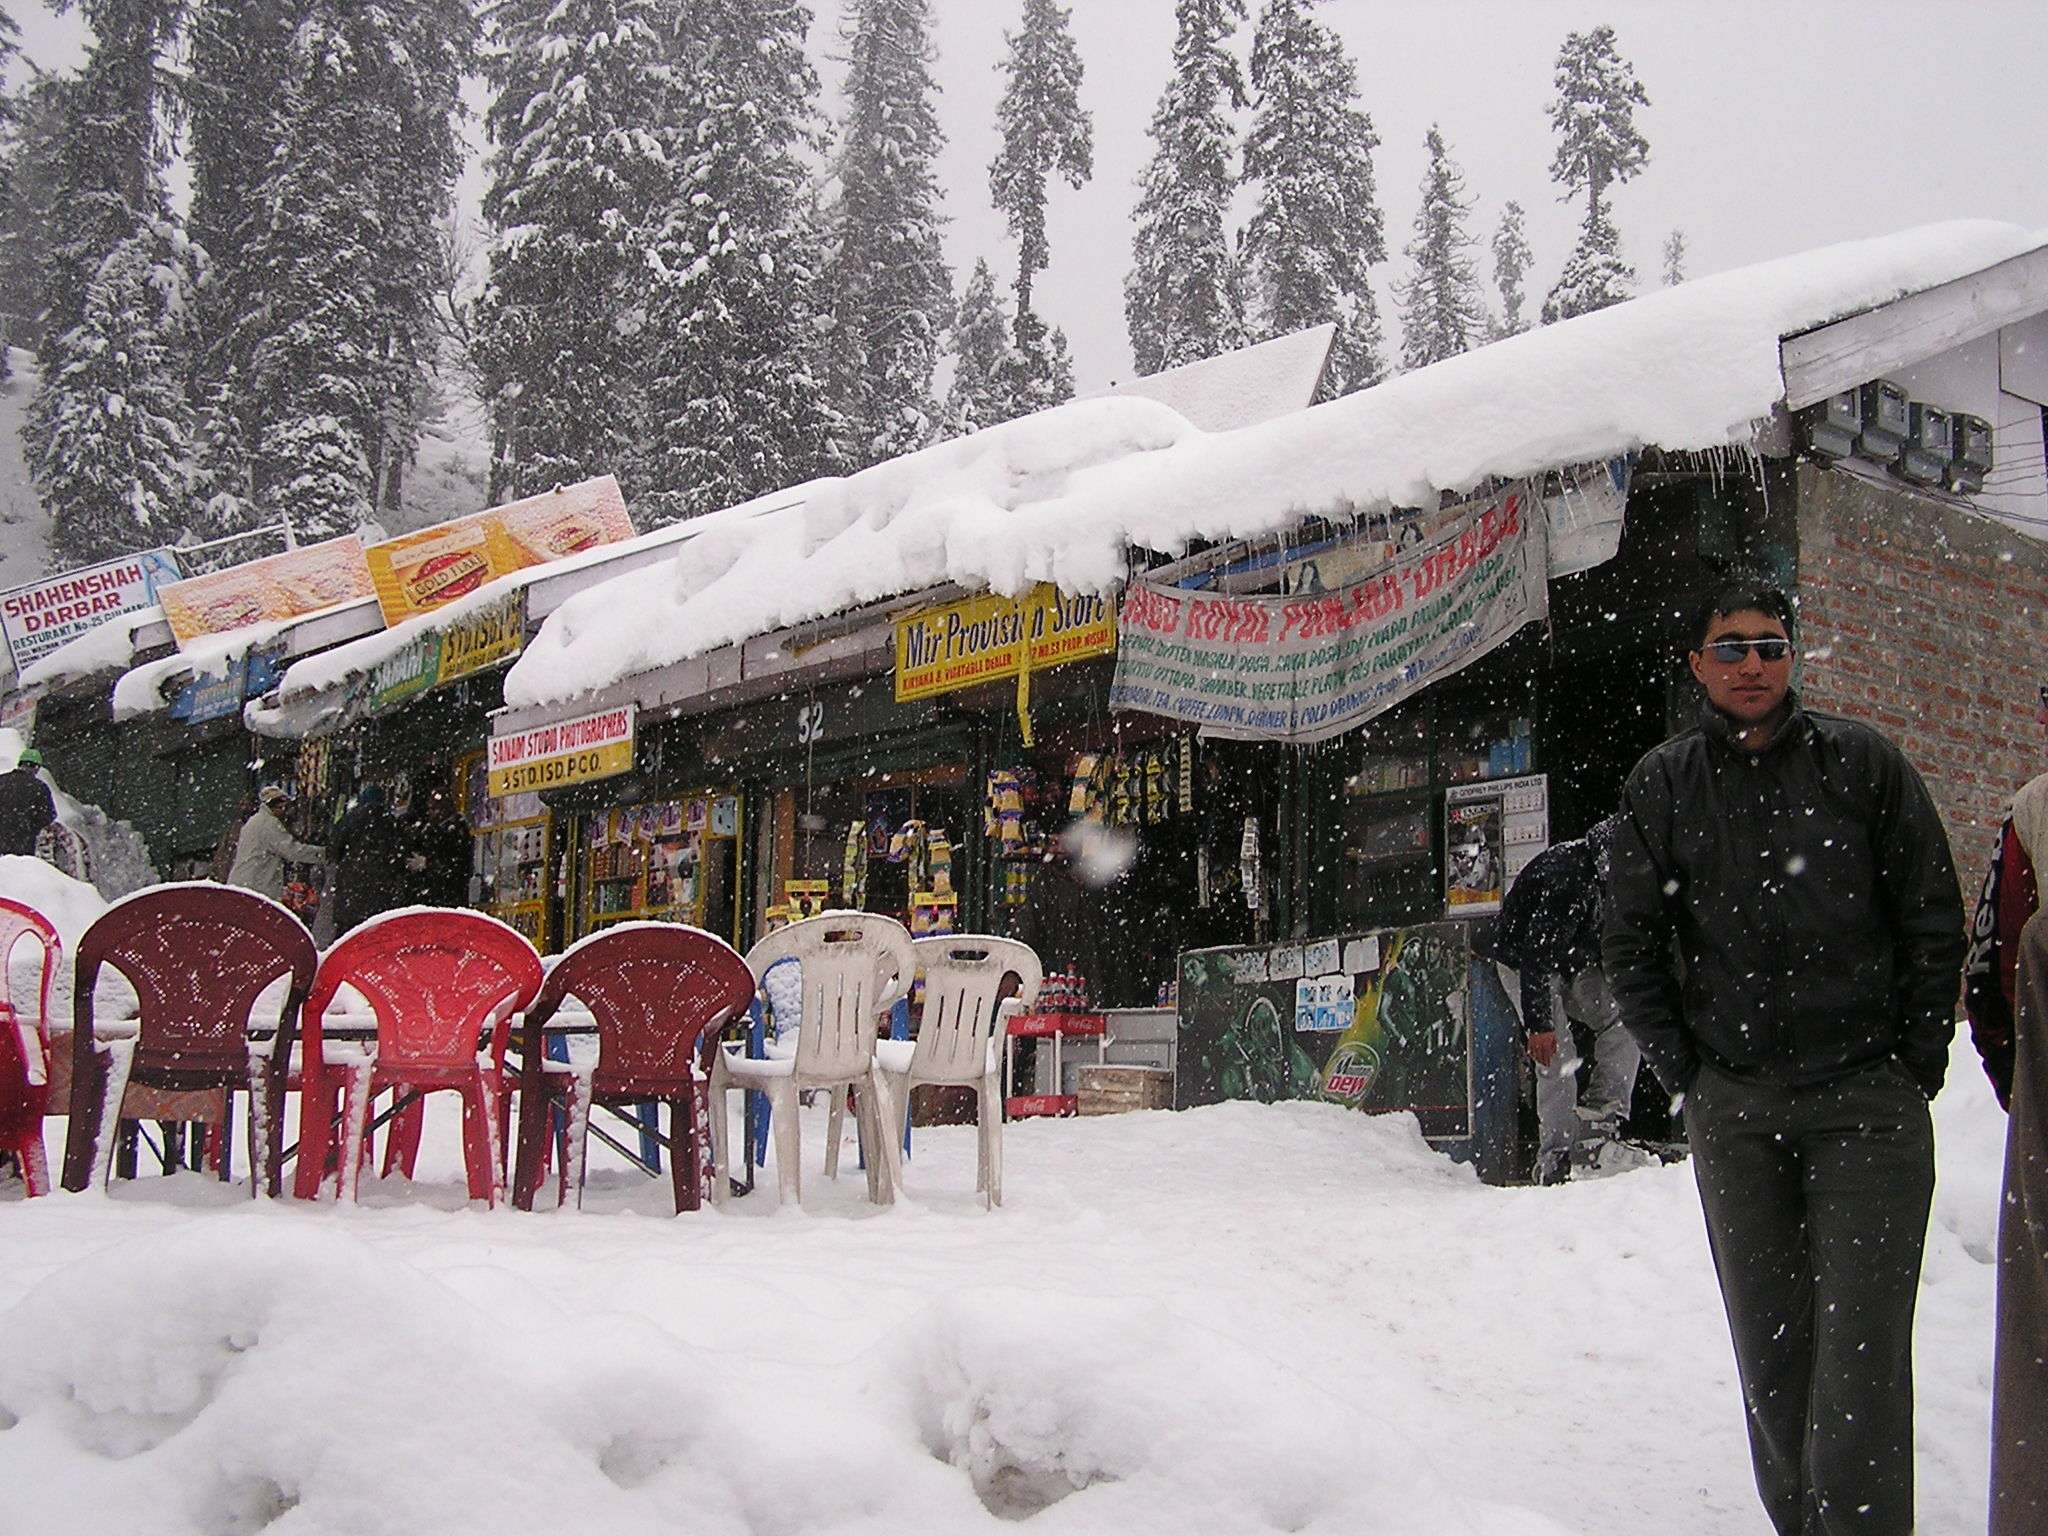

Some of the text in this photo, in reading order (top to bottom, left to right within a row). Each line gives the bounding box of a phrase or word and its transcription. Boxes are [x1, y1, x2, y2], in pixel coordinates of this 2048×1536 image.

[4, 564, 144, 619] SHAHENSHAH
[414, 569, 450, 597] GOLD
[25, 592, 123, 632] DARBAR
[1185, 599, 1270, 643] ROYAL
[12, 624, 72, 651] RESTURANT
[904, 621, 942, 670] Mir
[944, 602, 1045, 661] Provisin
[492, 709, 628, 765] SANAM STUDIO PHOTOGRAPHERS
